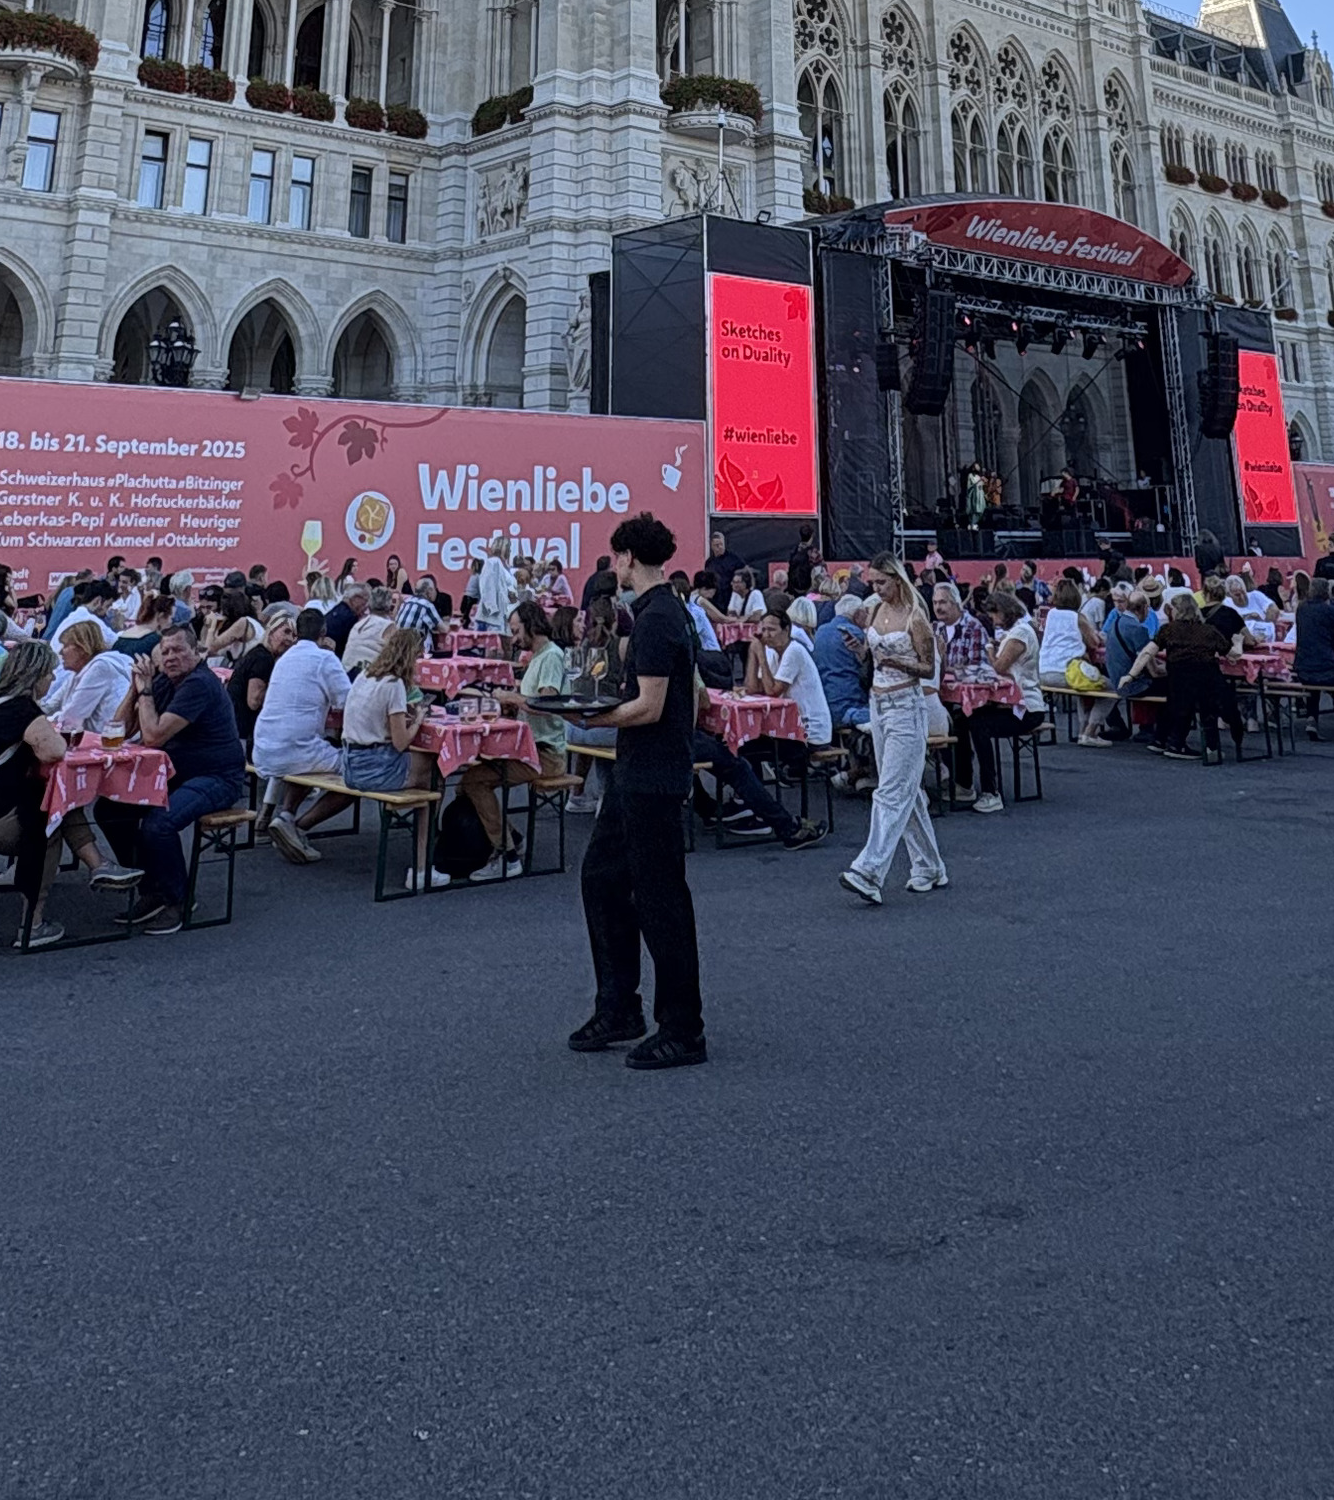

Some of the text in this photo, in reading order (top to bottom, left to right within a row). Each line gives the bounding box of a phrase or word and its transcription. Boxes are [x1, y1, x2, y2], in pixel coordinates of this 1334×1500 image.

[966, 215, 1143, 266] Wienliebe Festival
[720, 319, 783, 342] Sketches
[721, 343, 791, 368] on Duality
[29, 431, 60, 451] bis
[63, 433, 91, 453] 21.
[94, 434, 198, 459] September
[201, 439, 246, 459] 2025
[723, 426, 798, 446] #wienliebe
[107, 473, 177, 489] #Plachutta
[177, 475, 244, 494] #Bitzinger
[418, 463, 630, 513] Wienliebe
[67, 492, 84, 507] K.
[90, 496, 103, 507] u.
[109, 492, 124, 508] K.
[130, 493, 243, 510] Hofzuckerbäcker
[110, 512, 171, 528] #Wiener
[179, 513, 242, 532] Heuriger
[27, 531, 101, 548] Schwarzen
[104, 532, 155, 548] Kameel
[156, 532, 240, 552] #Ottakringer
